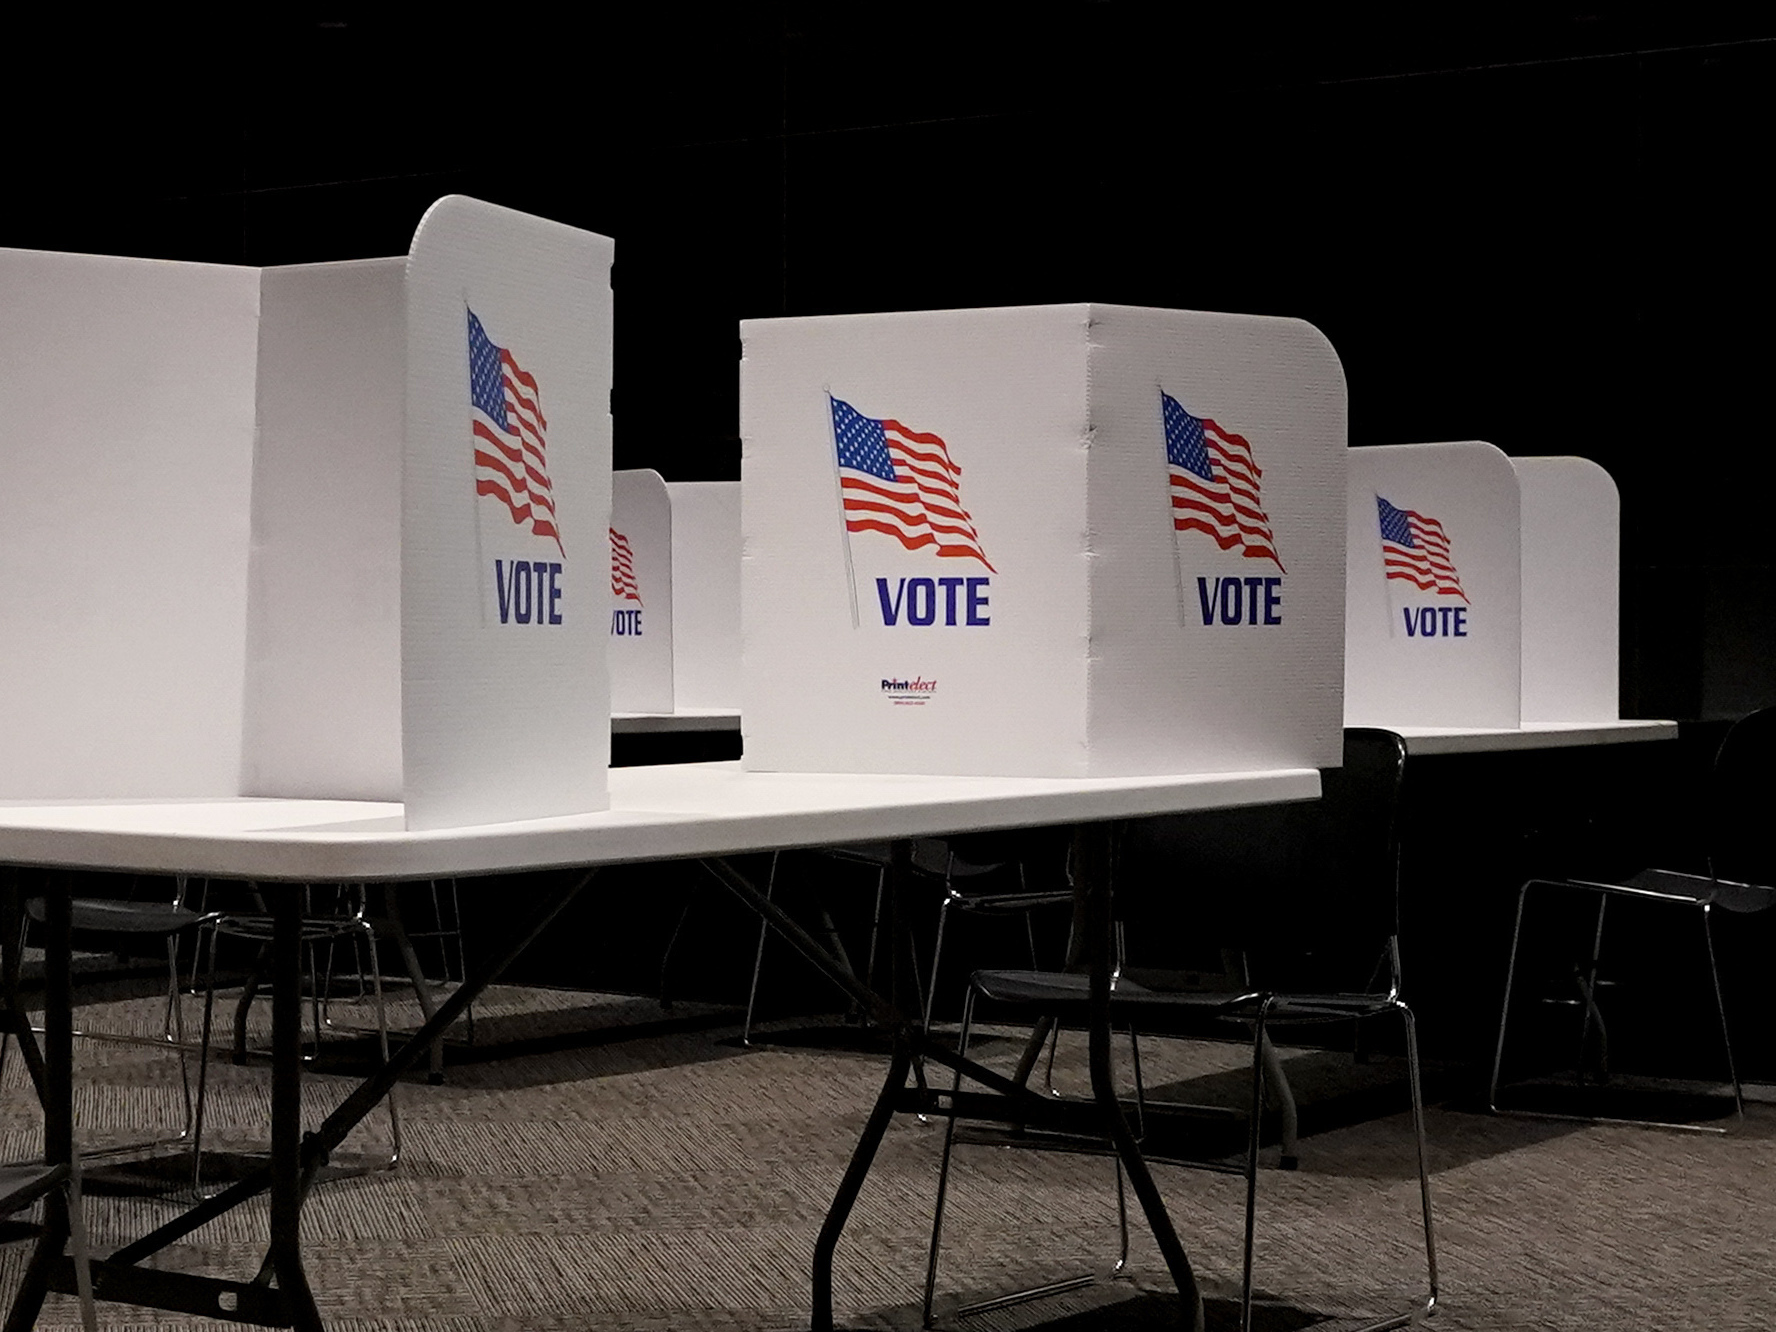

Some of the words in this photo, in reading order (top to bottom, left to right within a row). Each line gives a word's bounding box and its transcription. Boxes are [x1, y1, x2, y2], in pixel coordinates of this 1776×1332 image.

[495, 559, 563, 625] VOTE
[875, 577, 991, 627] VOTE
[1196, 576, 1282, 626] VOTE
[1403, 606, 1468, 637] VOTE
[881, 676, 937, 691] Printelect
